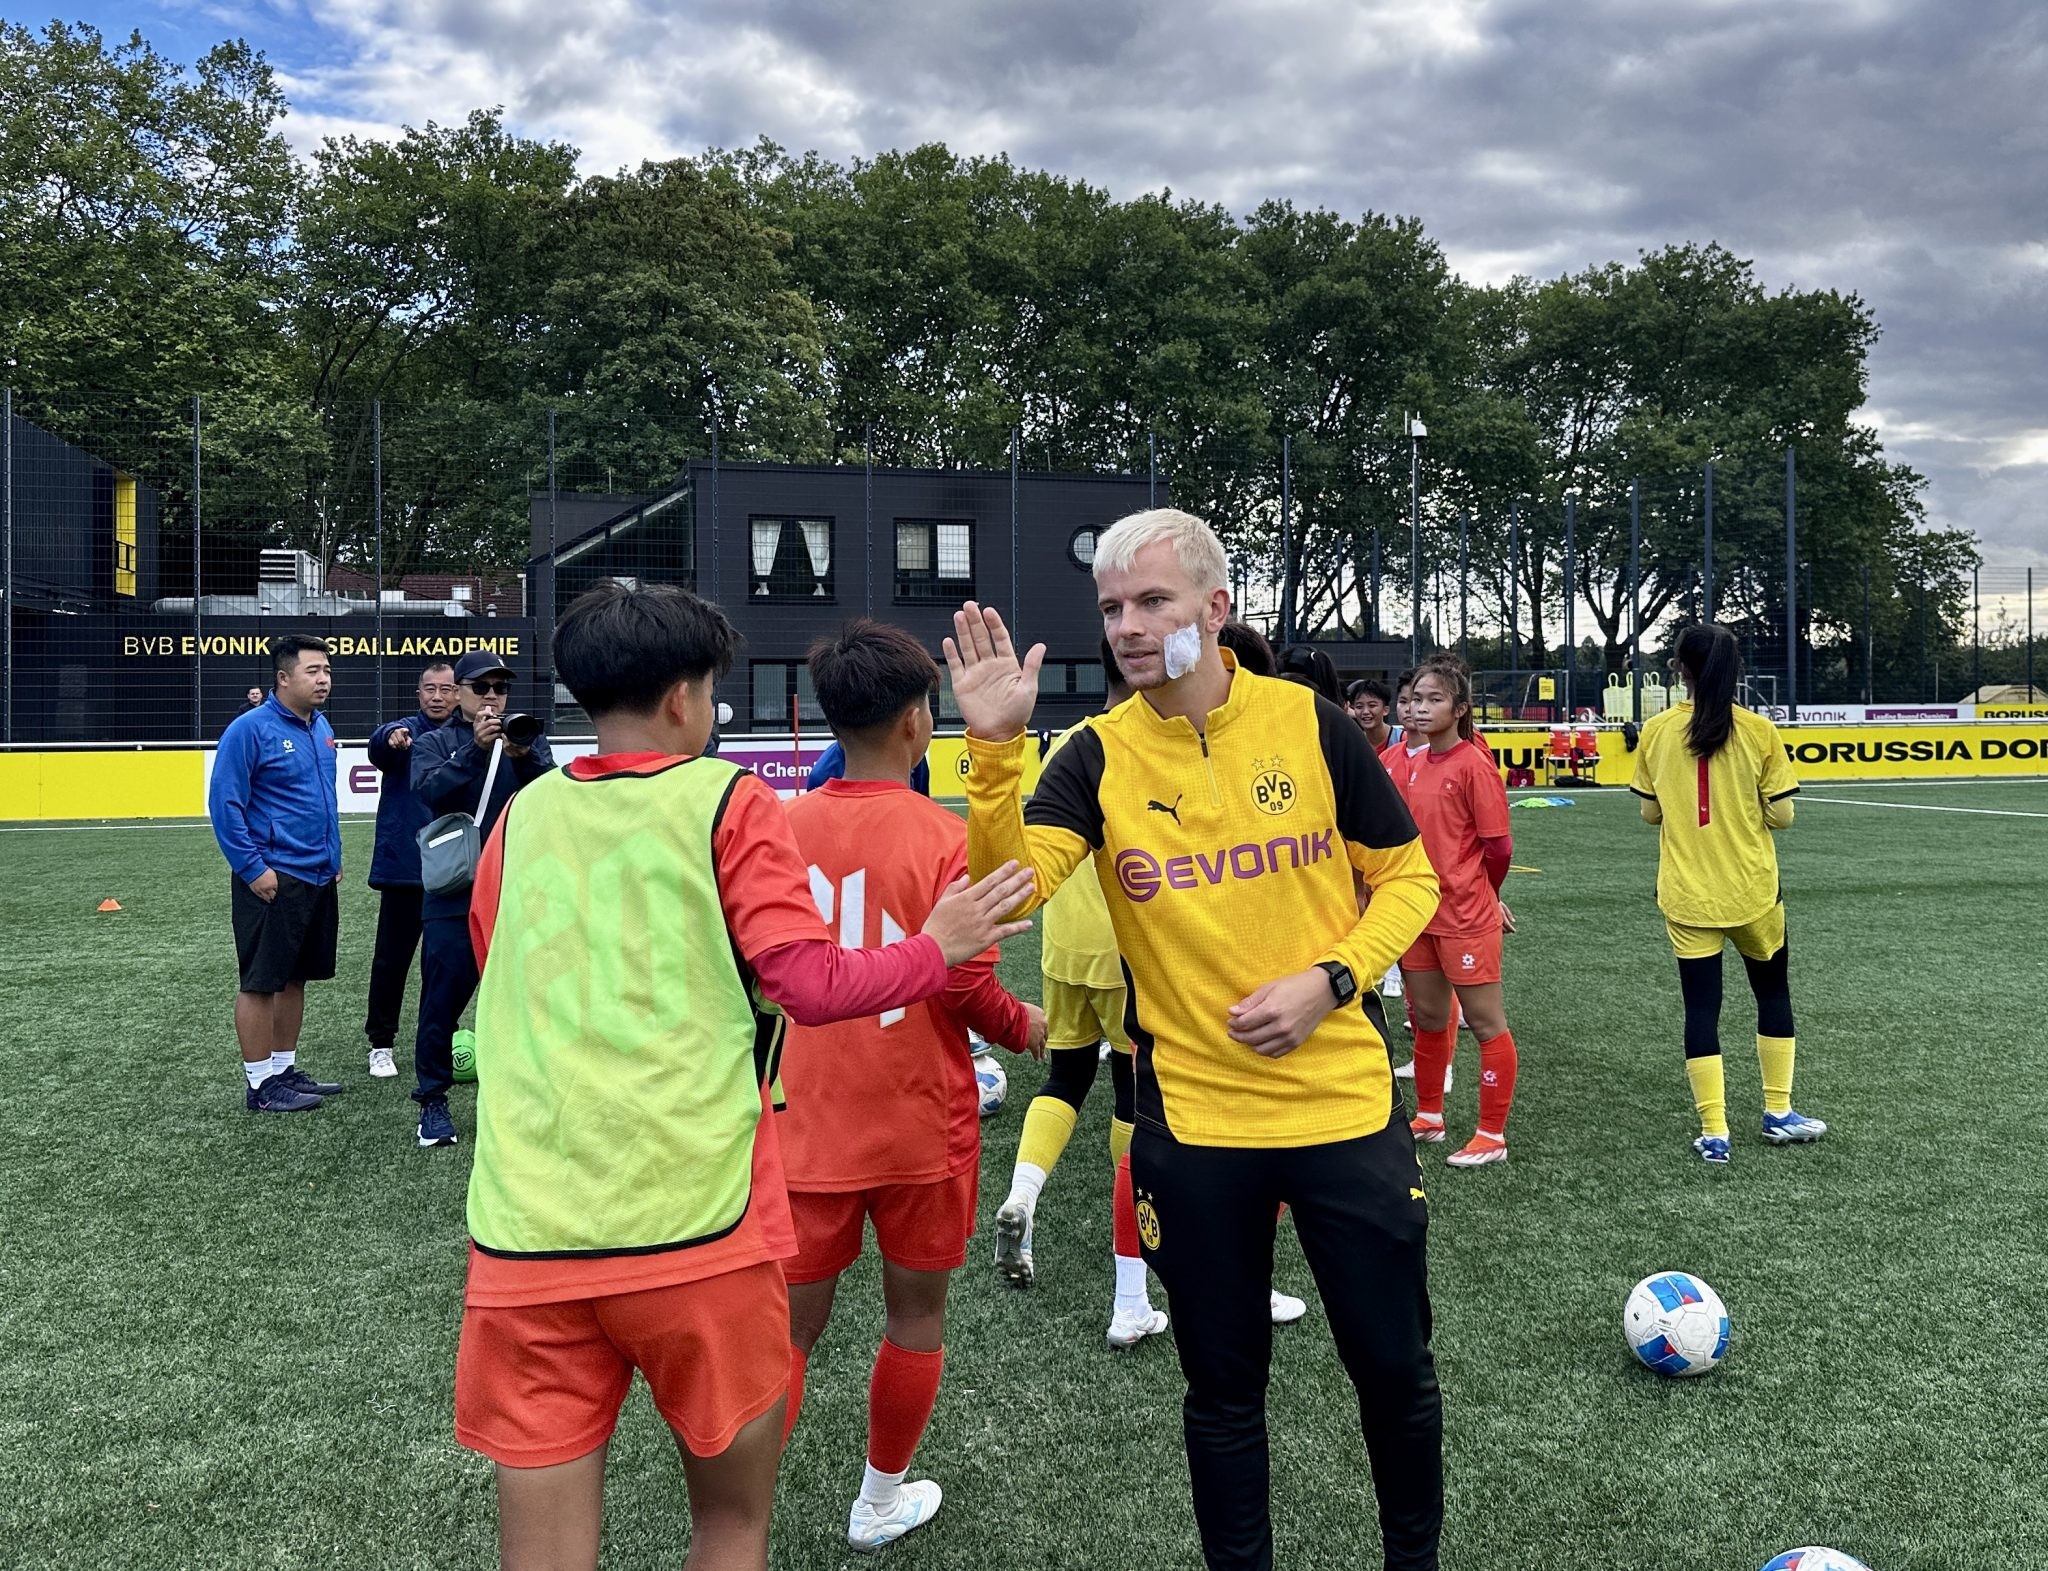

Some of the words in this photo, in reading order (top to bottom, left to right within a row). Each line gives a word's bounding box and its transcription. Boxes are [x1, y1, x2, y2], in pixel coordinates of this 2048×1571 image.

[124, 636, 174, 656] BVB
[181, 636, 271, 656] EVONIK
[1983, 710, 2048, 719] BORUS
[1256, 773, 1292, 804] BVB
[1270, 800, 1283, 811] 09
[1165, 828, 1333, 889] EVONIK
[1139, 1205, 1157, 1238] BVB
